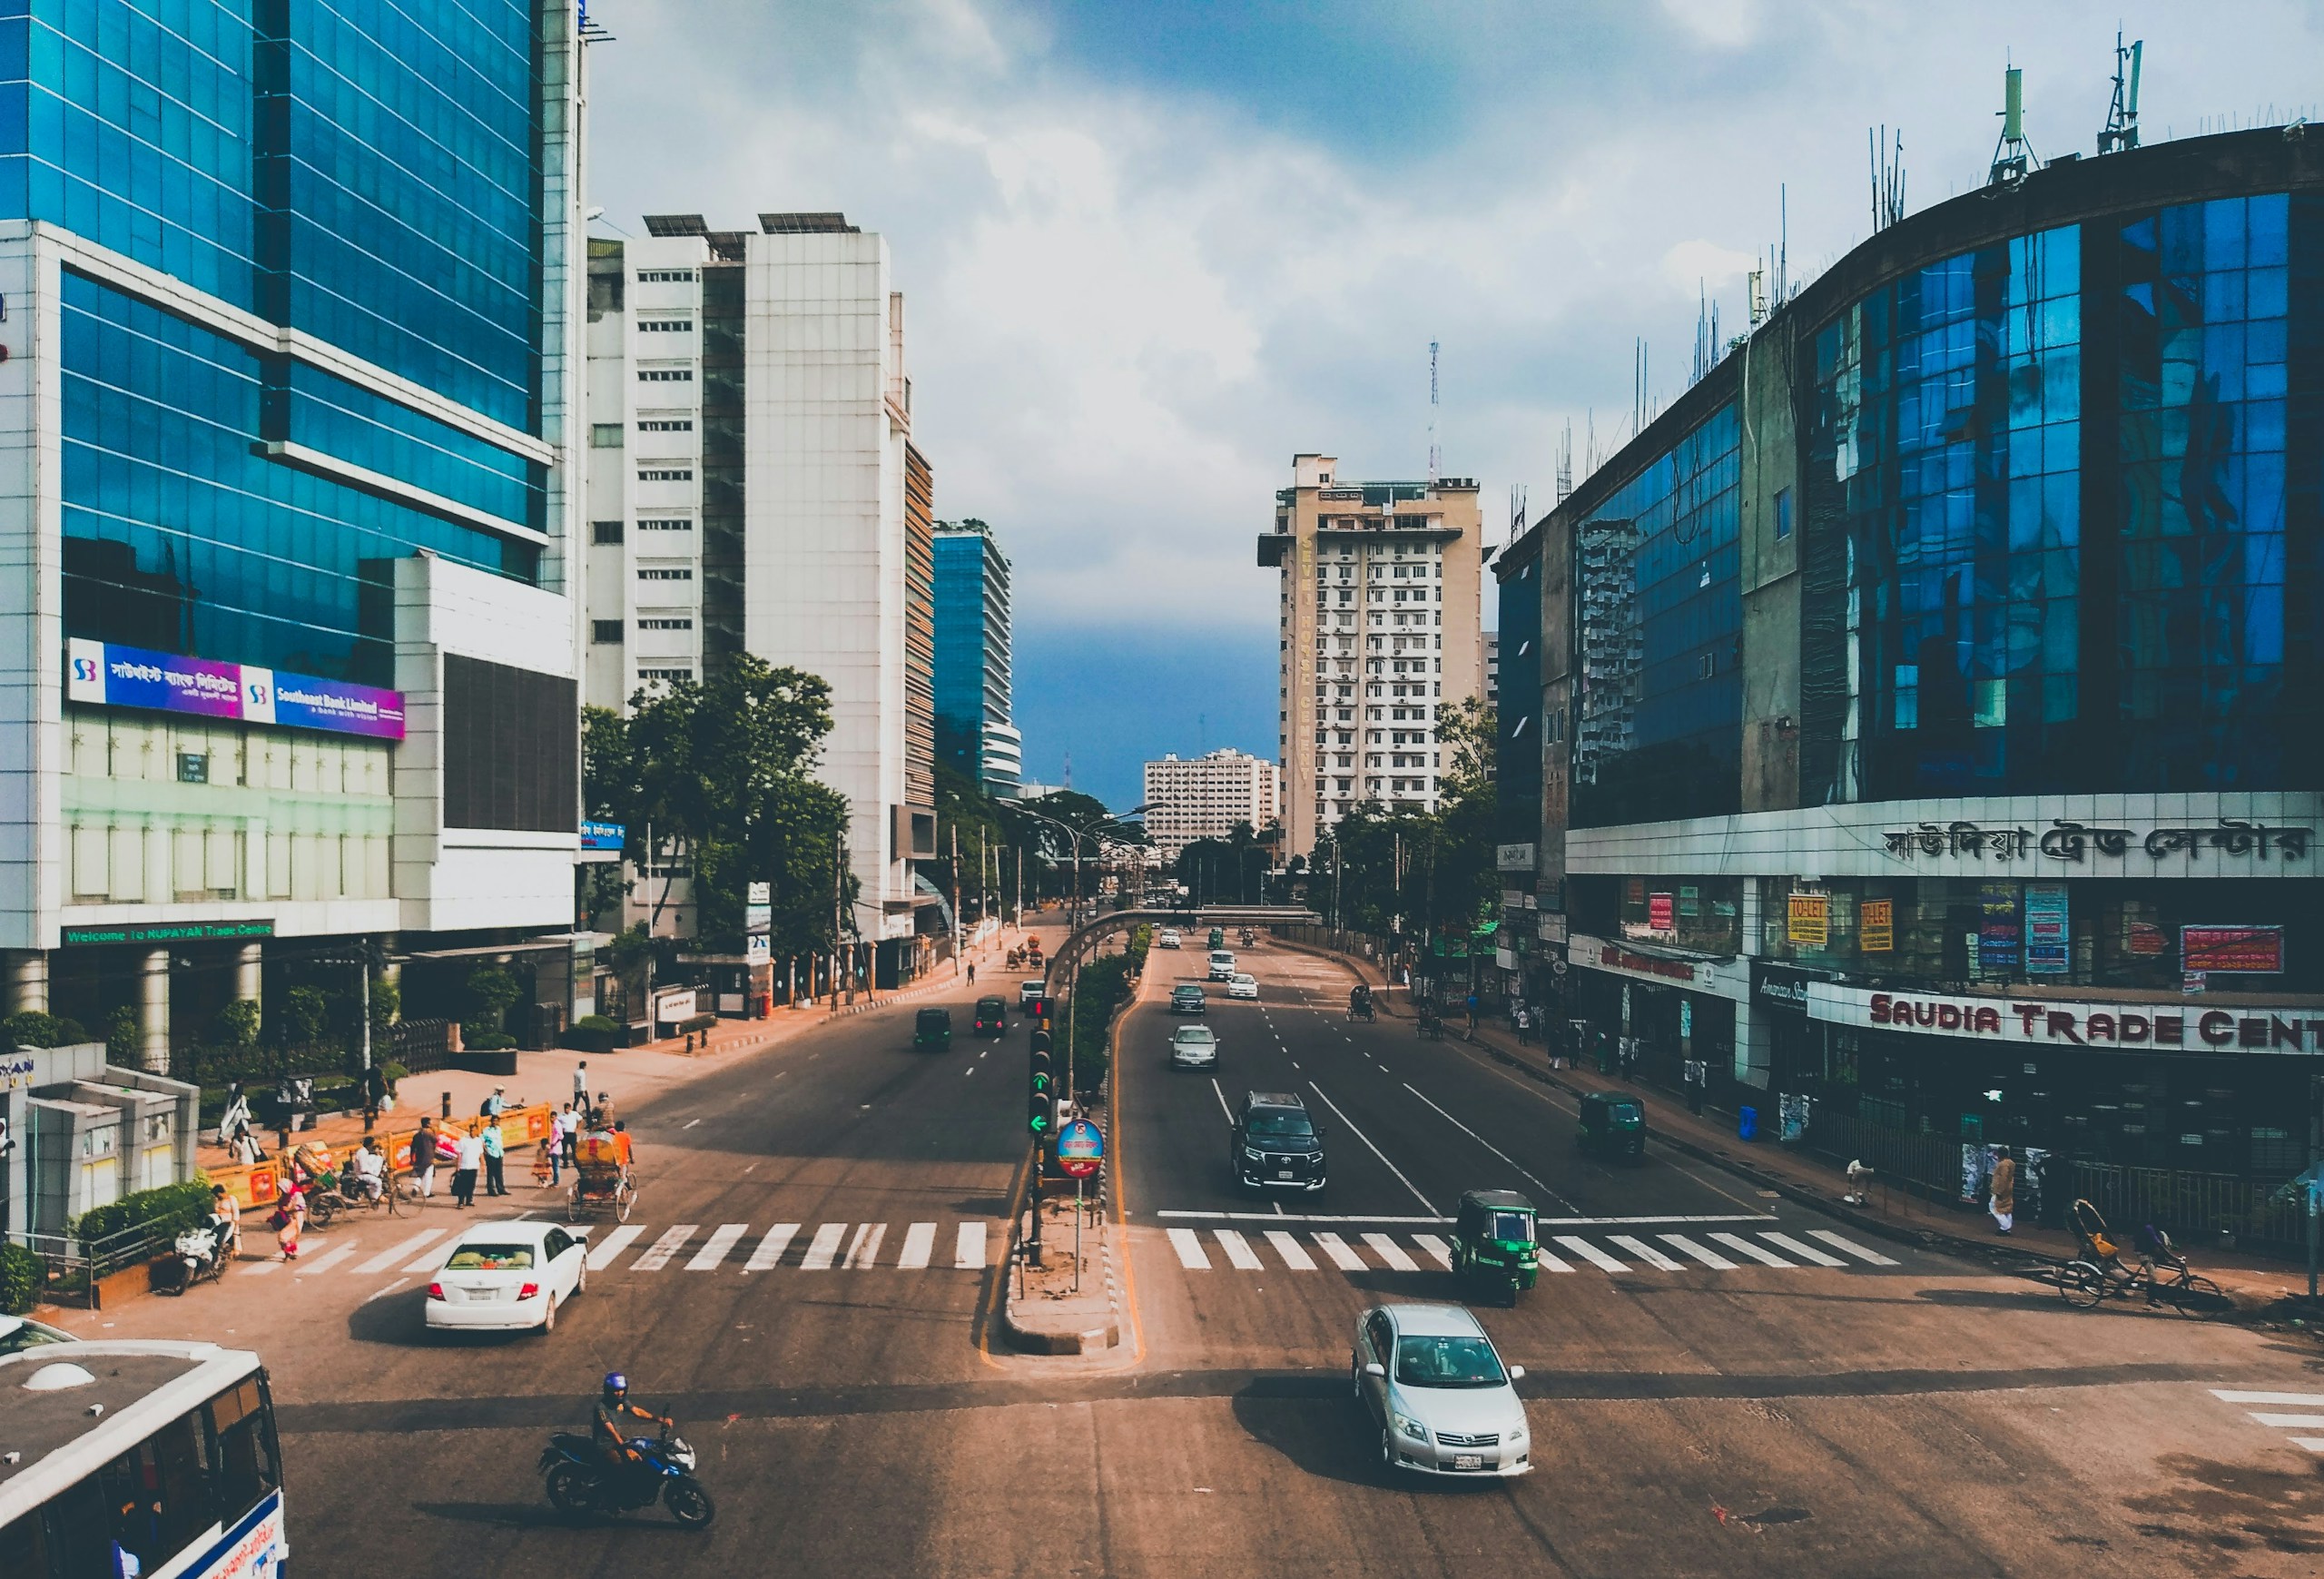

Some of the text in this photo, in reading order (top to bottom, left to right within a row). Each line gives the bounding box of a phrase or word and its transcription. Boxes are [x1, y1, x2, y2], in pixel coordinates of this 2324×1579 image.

[1299, 537, 1313, 781] SEVEN HORSE CEMENT
[163, 669, 195, 687] ব্যাংক
[195, 672, 238, 694] লিমিটেড
[277, 686, 322, 707] Southeast
[323, 693, 347, 709] Bank
[347, 696, 378, 715] Limited
[318, 706, 337, 715] bank
[338, 709, 355, 718] with
[356, 714, 378, 722] vision
[2041, 819, 2136, 863] ট্রেড
[2145, 818, 2317, 862] সেন্টার
[1791, 899, 1824, 919] TO-LET
[68, 932, 125, 942] Welcome
[204, 925, 235, 936] Trade
[1760, 976, 1792, 999] American
[1870, 993, 2001, 1034] SAUDIA
[2013, 1002, 2183, 1045] TRADE
